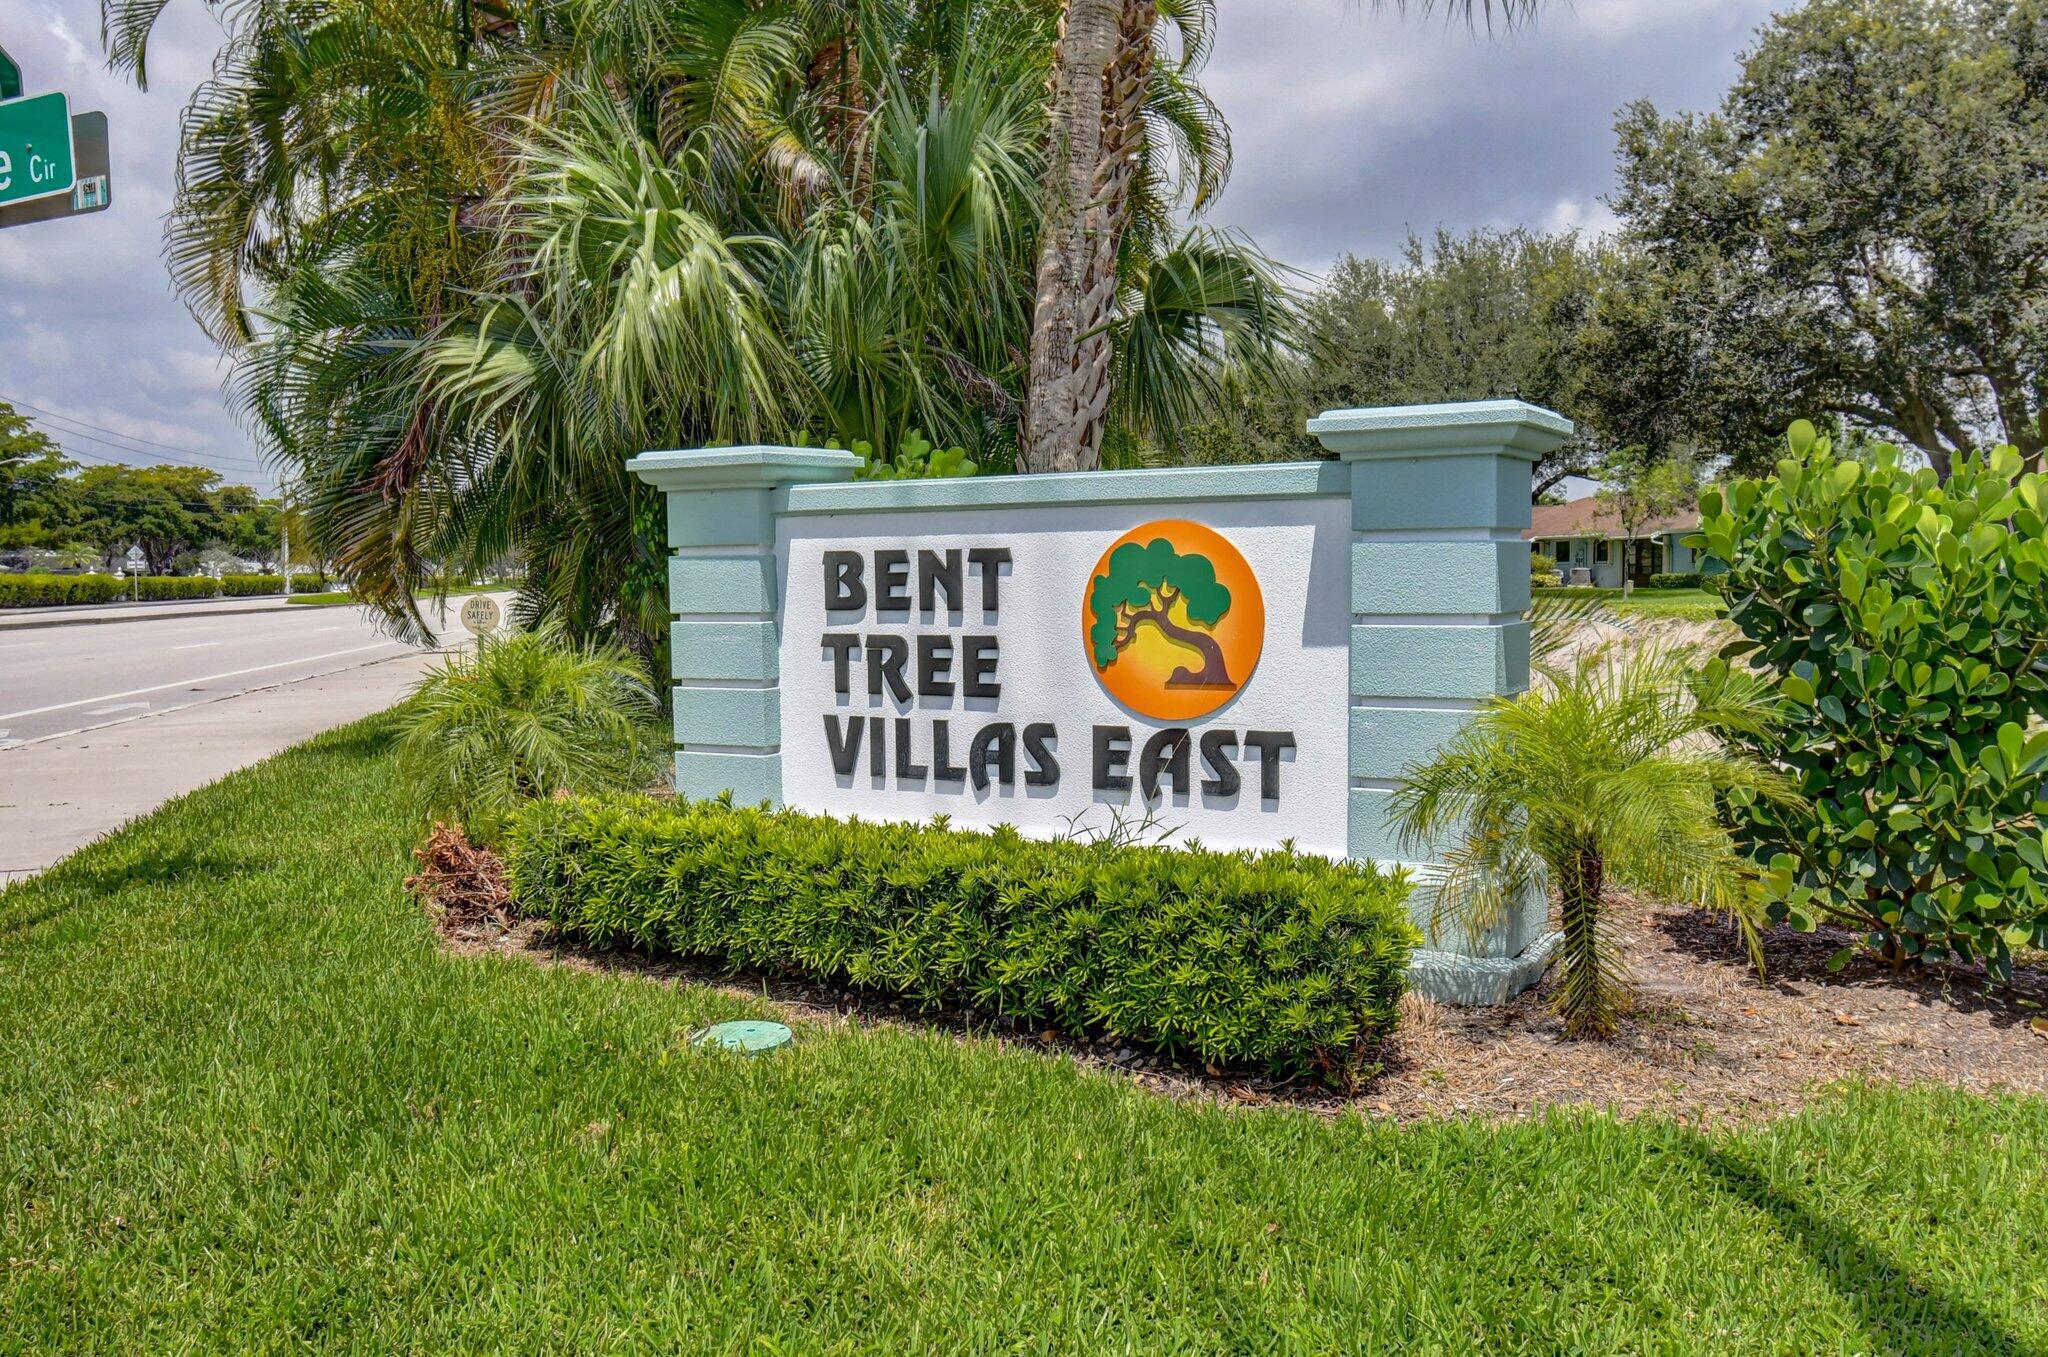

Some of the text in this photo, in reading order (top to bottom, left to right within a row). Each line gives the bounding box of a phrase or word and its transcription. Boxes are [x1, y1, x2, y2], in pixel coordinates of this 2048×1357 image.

[30, 155, 55, 182] Cir
[822, 547, 1012, 611] BENT
[467, 611, 493, 620] SAFELY
[470, 600, 490, 609] DRIVE
[821, 633, 1000, 703] TREE
[822, 714, 1297, 801] VILLAS EAST
